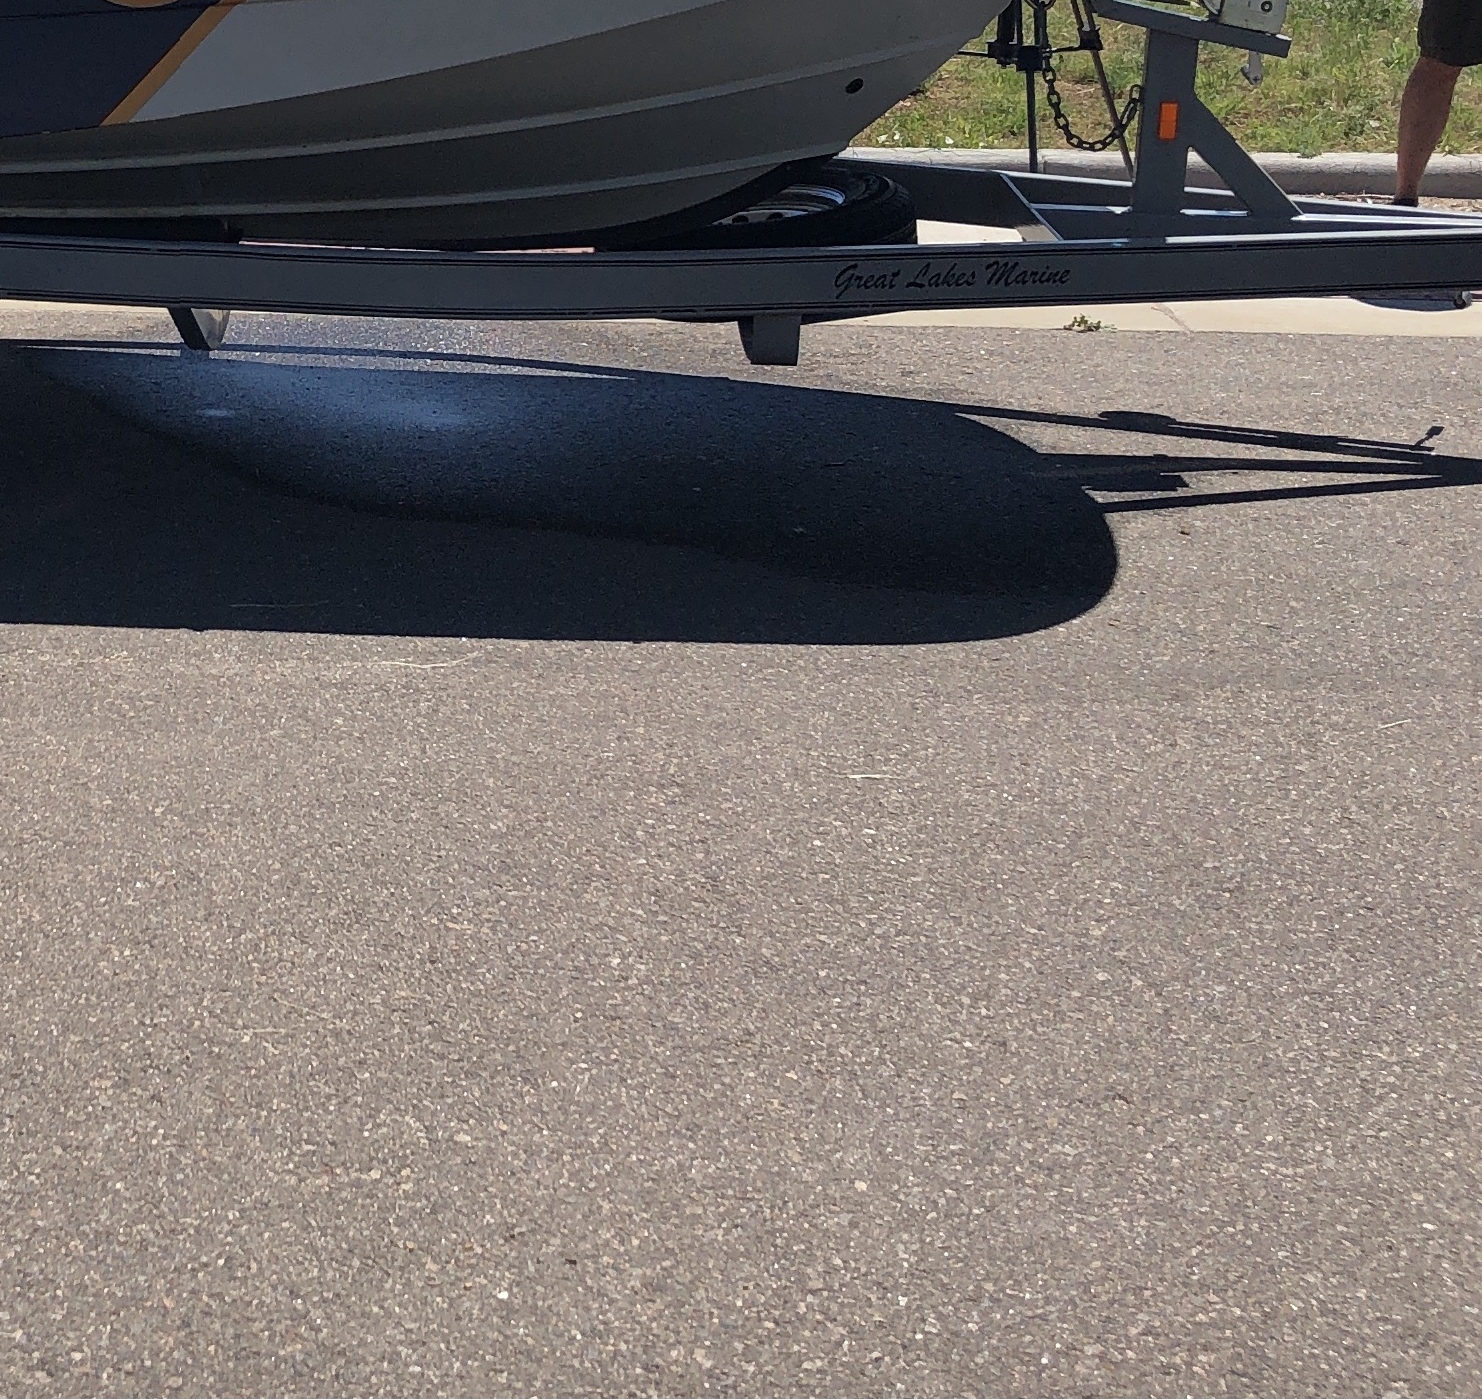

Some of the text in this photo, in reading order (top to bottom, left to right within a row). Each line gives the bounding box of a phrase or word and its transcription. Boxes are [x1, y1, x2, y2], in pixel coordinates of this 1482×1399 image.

[834, 260, 1071, 299] Great Lakes Marine
